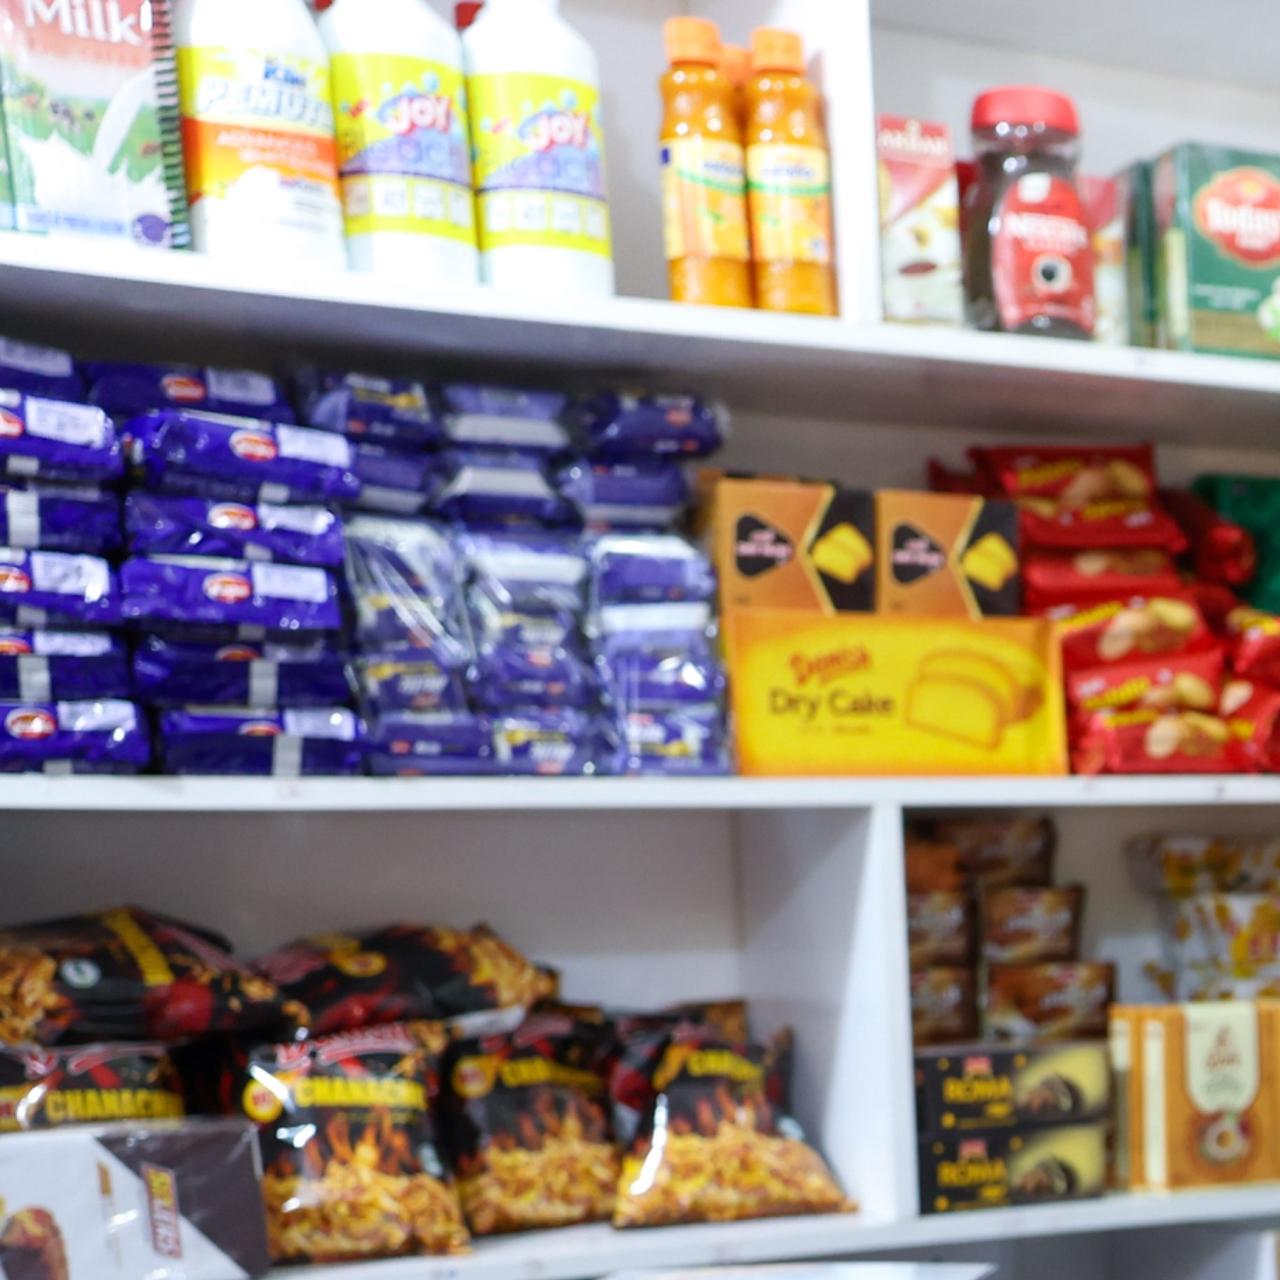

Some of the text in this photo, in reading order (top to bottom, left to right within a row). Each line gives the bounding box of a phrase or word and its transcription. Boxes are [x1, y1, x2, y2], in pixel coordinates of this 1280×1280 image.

[23, 0, 142, 47] Milk
[769, 688, 895, 719] Dry Cake
